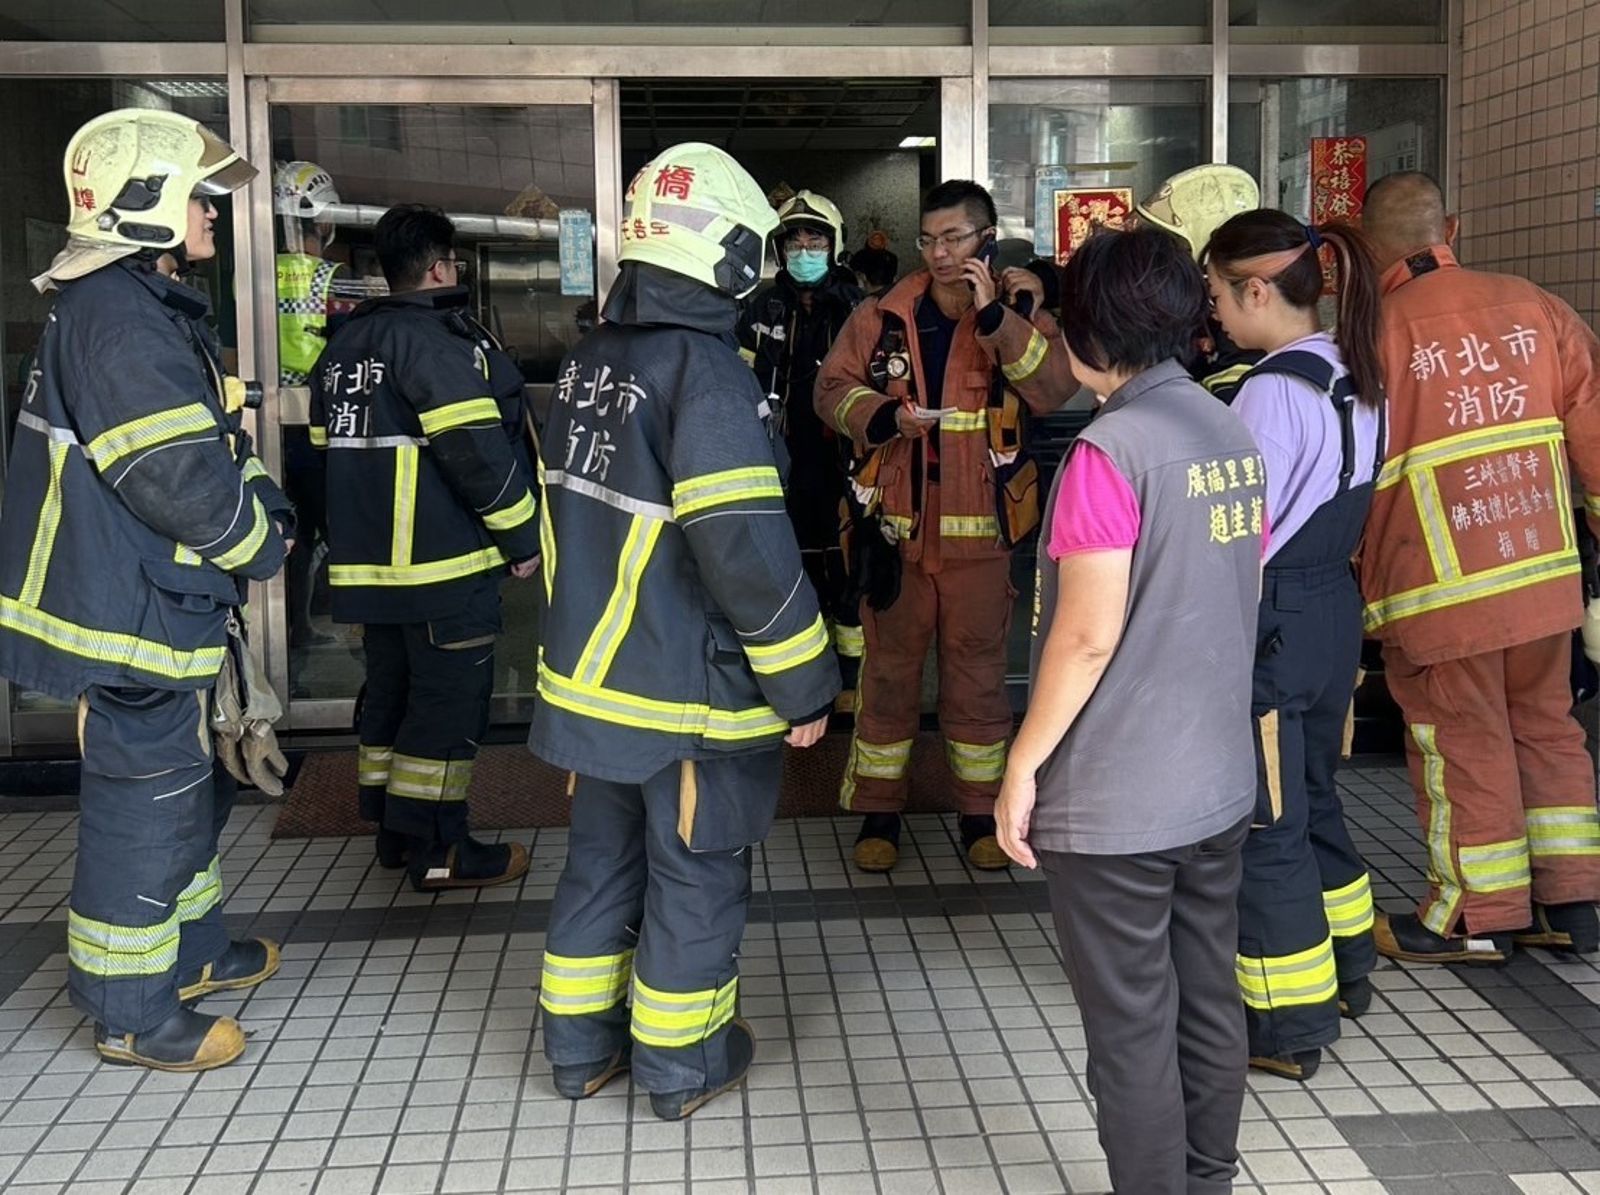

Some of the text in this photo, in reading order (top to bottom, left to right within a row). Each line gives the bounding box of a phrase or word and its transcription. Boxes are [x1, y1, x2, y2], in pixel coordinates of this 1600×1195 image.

[1409, 324, 1538, 381] 新北市
[328, 401, 371, 437] 消
[1444, 377, 1529, 427] 消防
[1187, 455, 1265, 498] 廣福里里
